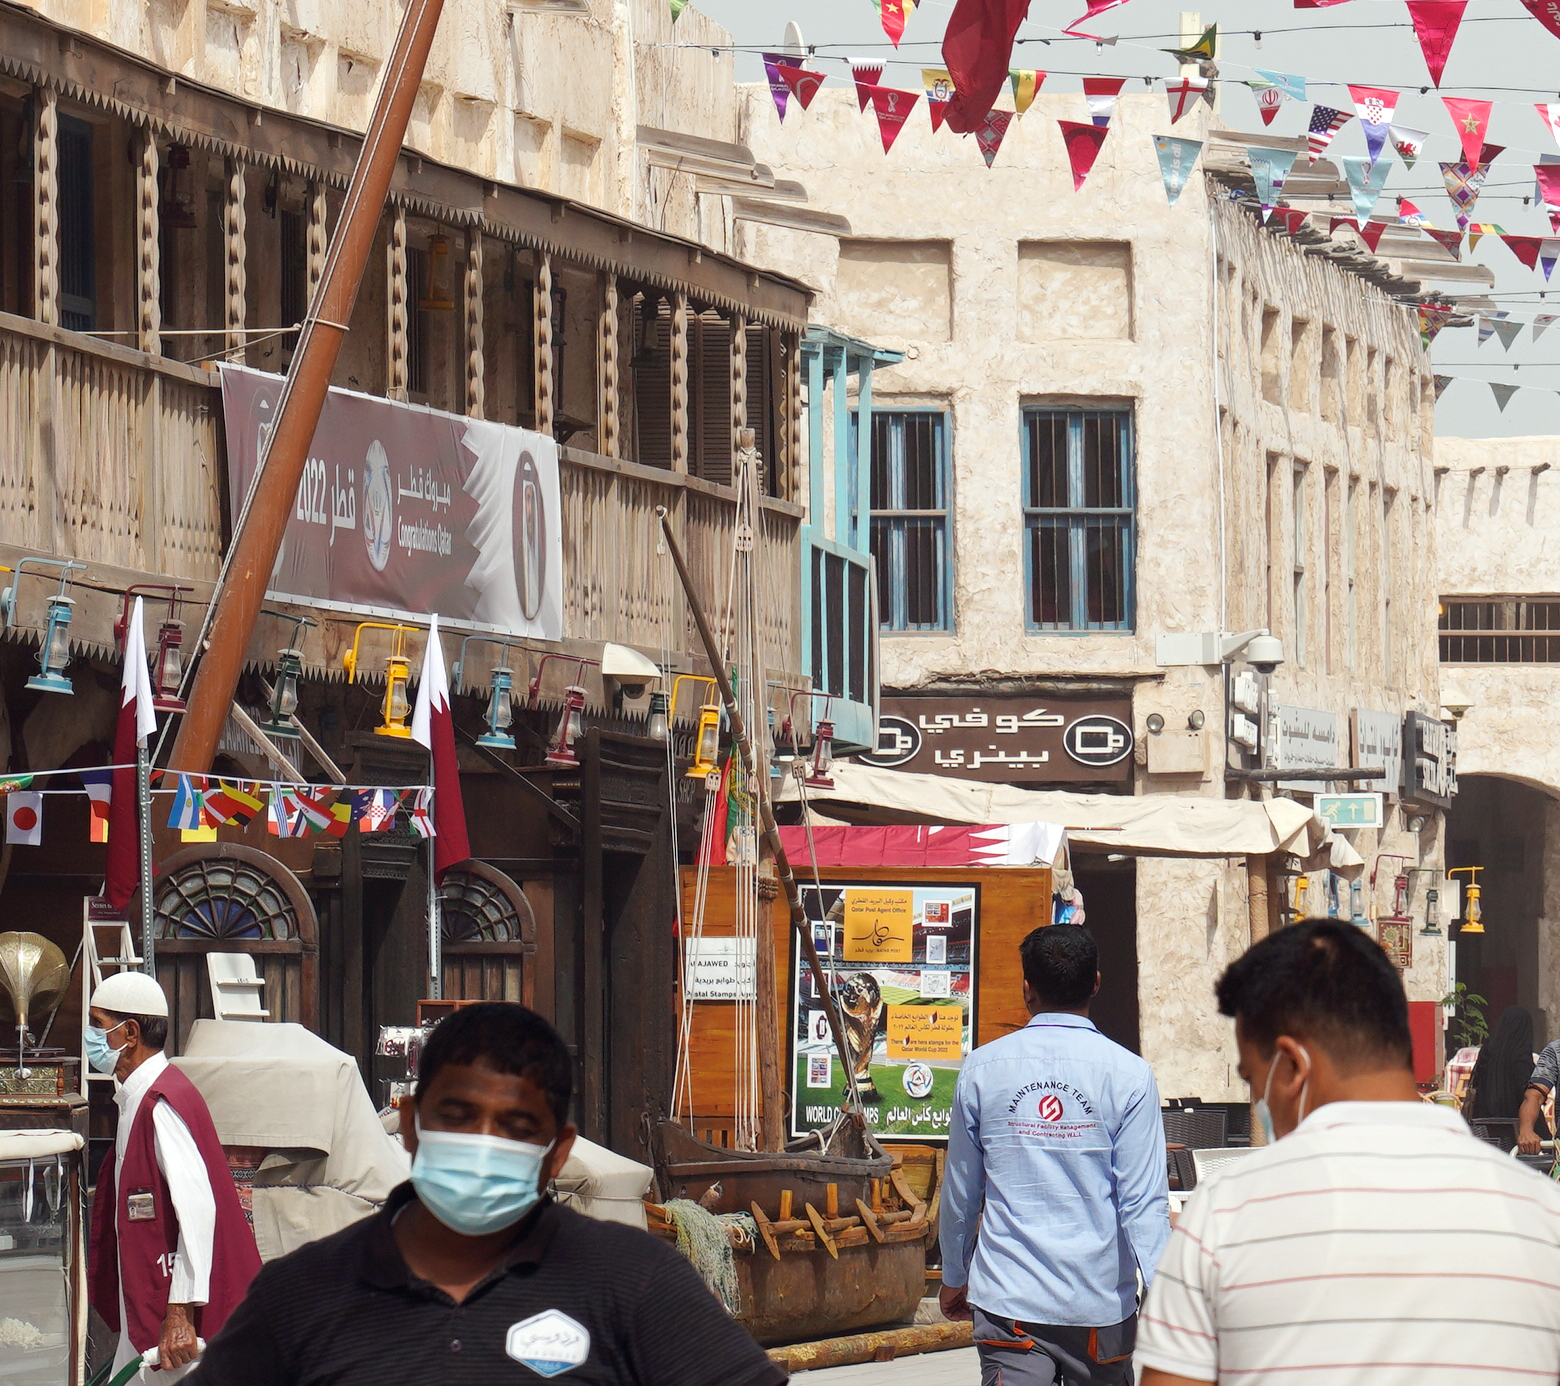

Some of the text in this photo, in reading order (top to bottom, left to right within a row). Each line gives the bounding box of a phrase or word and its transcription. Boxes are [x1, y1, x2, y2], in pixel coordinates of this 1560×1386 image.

[397, 464, 451, 513] مبروك قطر
[297, 458, 356, 547] قطر 2022
[398, 515, 452, 558] Congratulations Qatar
[934, 744, 1049, 769] بينري
[709, 990, 736, 998] Stamps
[1008, 1080, 1093, 1115] MAINTENANCE TEAM
[806, 1106, 832, 1123] WORLD
[886, 1106, 911, 1125] العالم
[912, 1103, 932, 1126] كأس
[1032, 1130, 1066, 1139] Contracting
[1037, 1122, 1059, 1131] Facility
